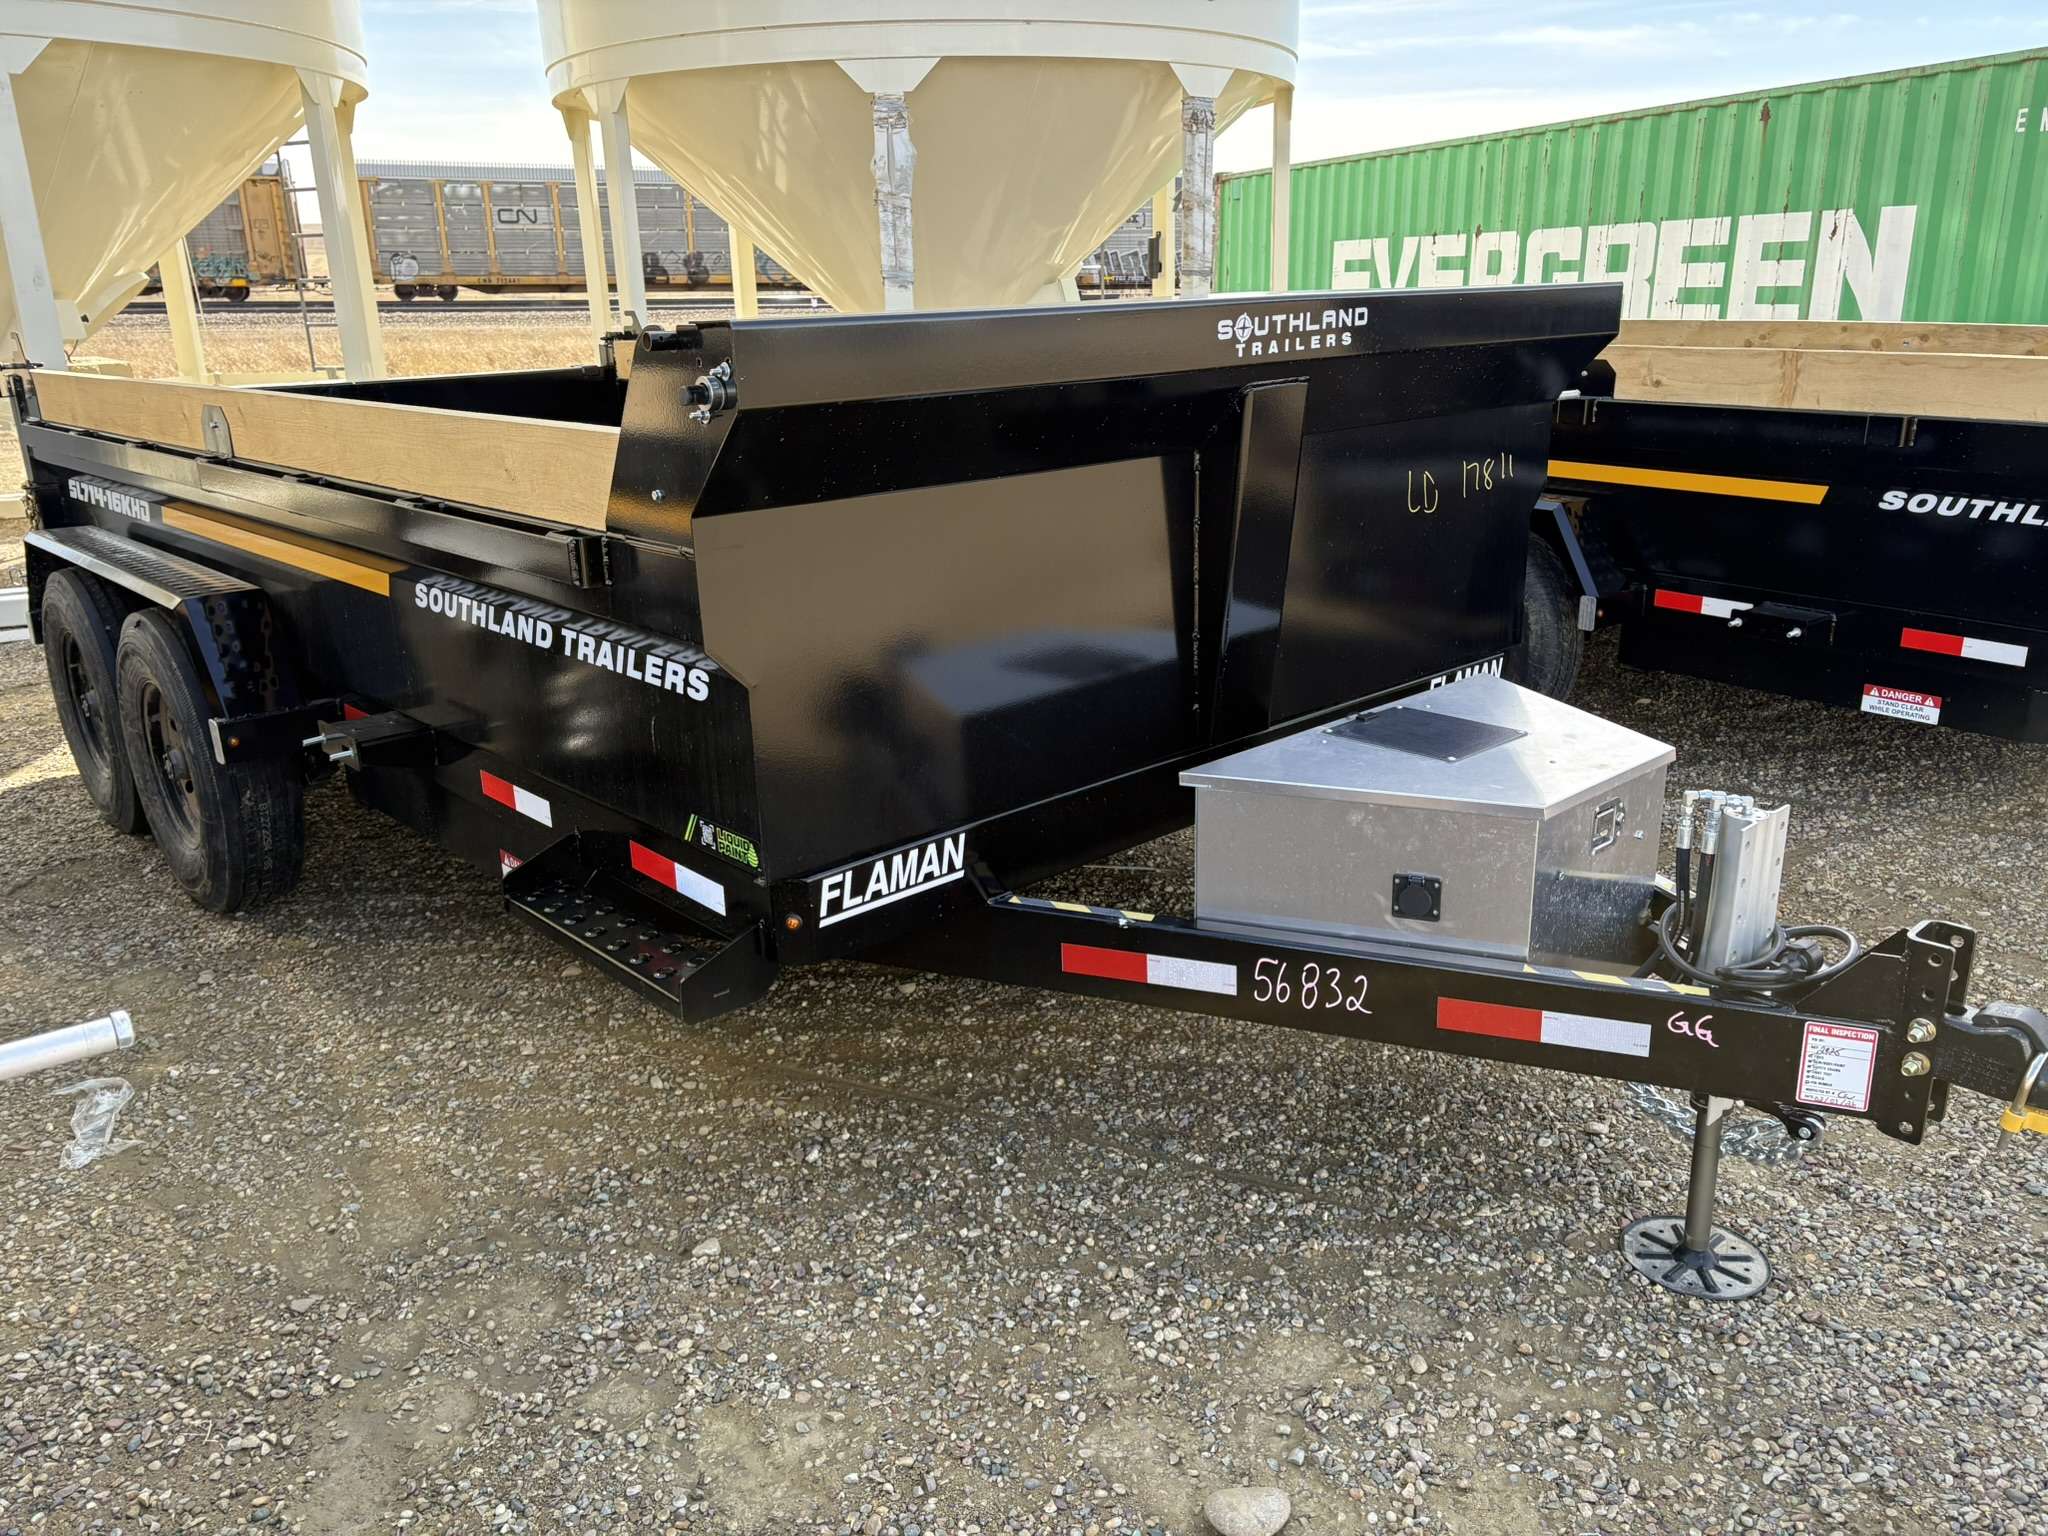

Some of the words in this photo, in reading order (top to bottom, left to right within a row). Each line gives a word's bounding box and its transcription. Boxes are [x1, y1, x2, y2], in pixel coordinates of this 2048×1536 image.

[497, 208, 538, 224] CN
[1331, 204, 1918, 322] EVERGREEN
[1217, 306, 1369, 343] SOUTHLAND
[1235, 331, 1353, 358] TRAILERS
[1407, 470, 1439, 513] LD
[1878, 490, 2048, 527] SOUTHL
[415, 582, 553, 650] SOUTHLAND
[561, 627, 710, 702] TRAILERS
[1868, 703, 1891, 714] WHILE
[1891, 708, 1930, 721] OPERATING
[1877, 699, 1900, 709] STAND
[1900, 703, 1924, 713] CLEAR
[1881, 688, 1923, 704] DANGER
[717, 839, 748, 864] PAINT
[819, 832, 966, 918] FLAMAN
[1253, 957, 1373, 1015] 56832
[1808, 1024, 1830, 1035] FINAL
[1830, 1028, 1876, 1041] INSPECTION
